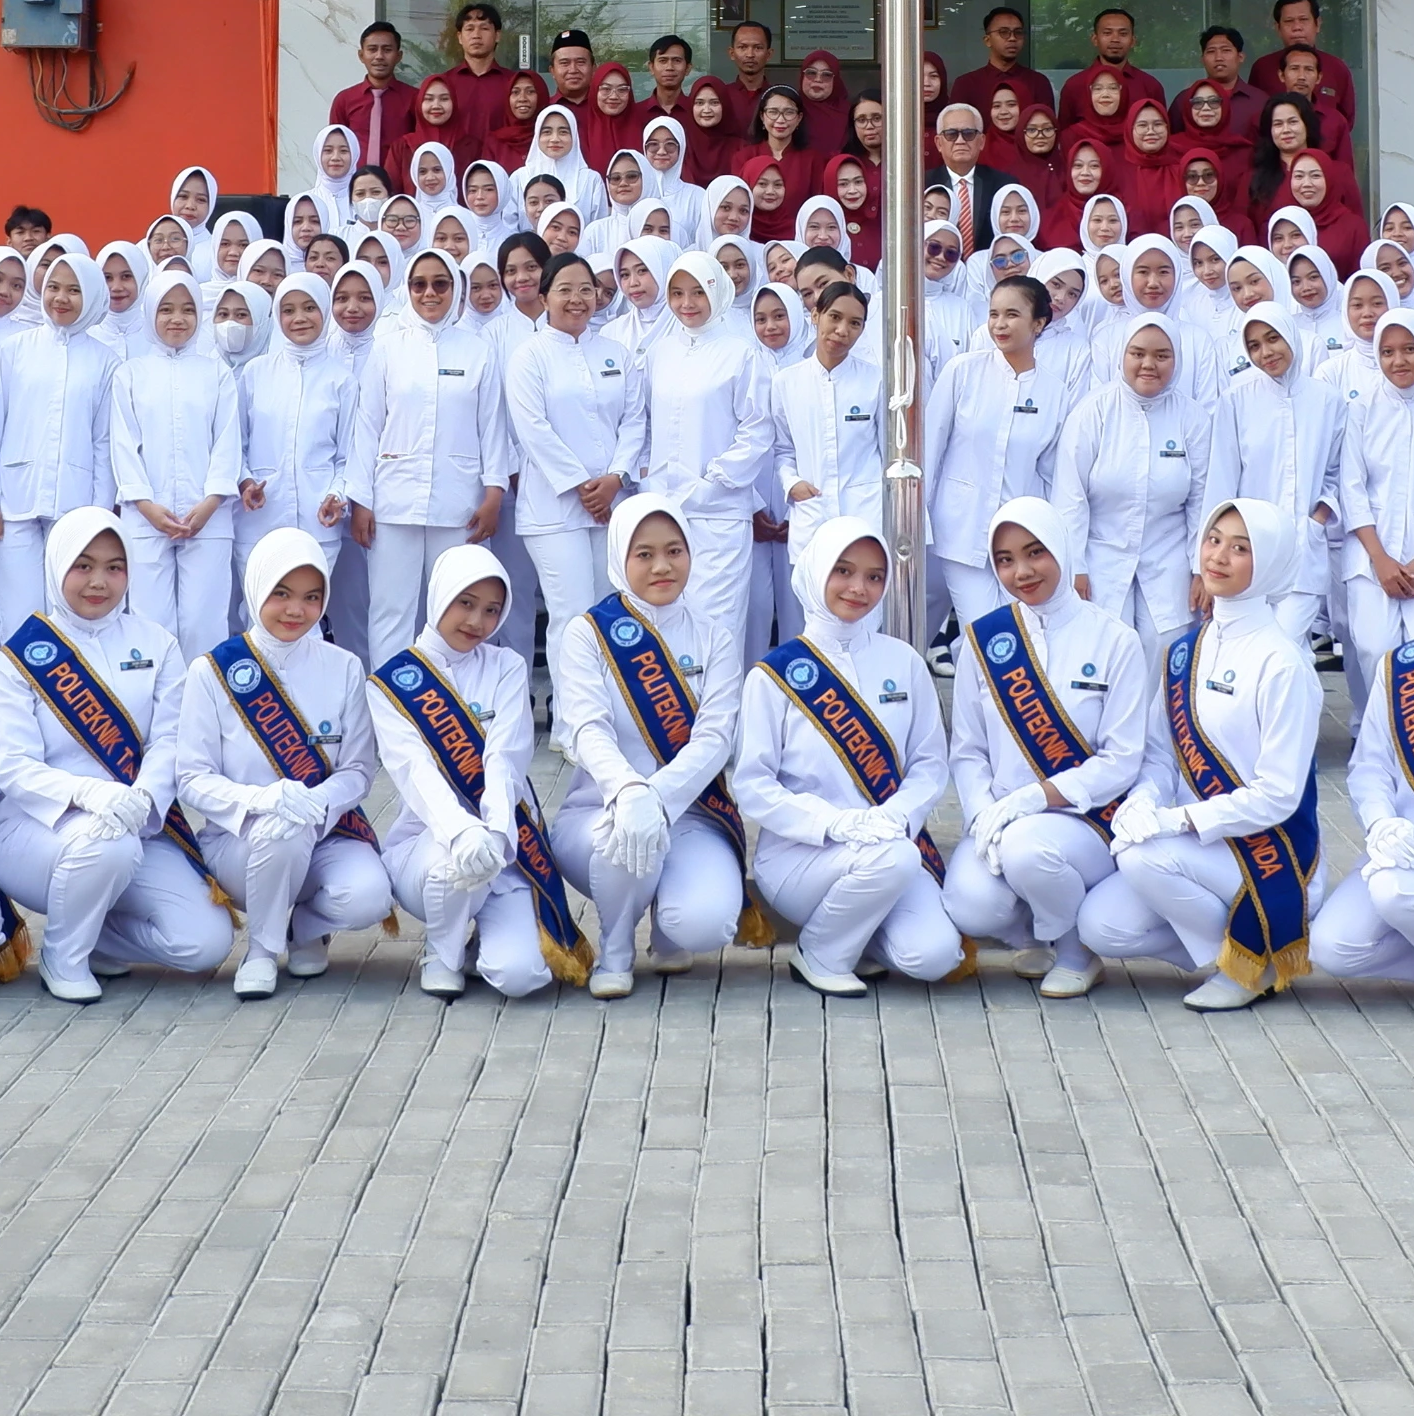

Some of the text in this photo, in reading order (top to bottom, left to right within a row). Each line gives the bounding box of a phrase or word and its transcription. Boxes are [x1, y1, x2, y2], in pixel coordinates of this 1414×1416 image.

[46, 661, 124, 756] POLITEKNIK
[247, 691, 321, 782] POLITEKNIK
[412, 688, 483, 784] POLITEKNIK
[813, 687, 890, 784] POLITEKNIK
[1000, 665, 1075, 769] POLITEKNIK
[1170, 679, 1203, 782] POLITEKNIK
[517, 824, 552, 883] BUNDA
[1242, 826, 1284, 881] UNDA
